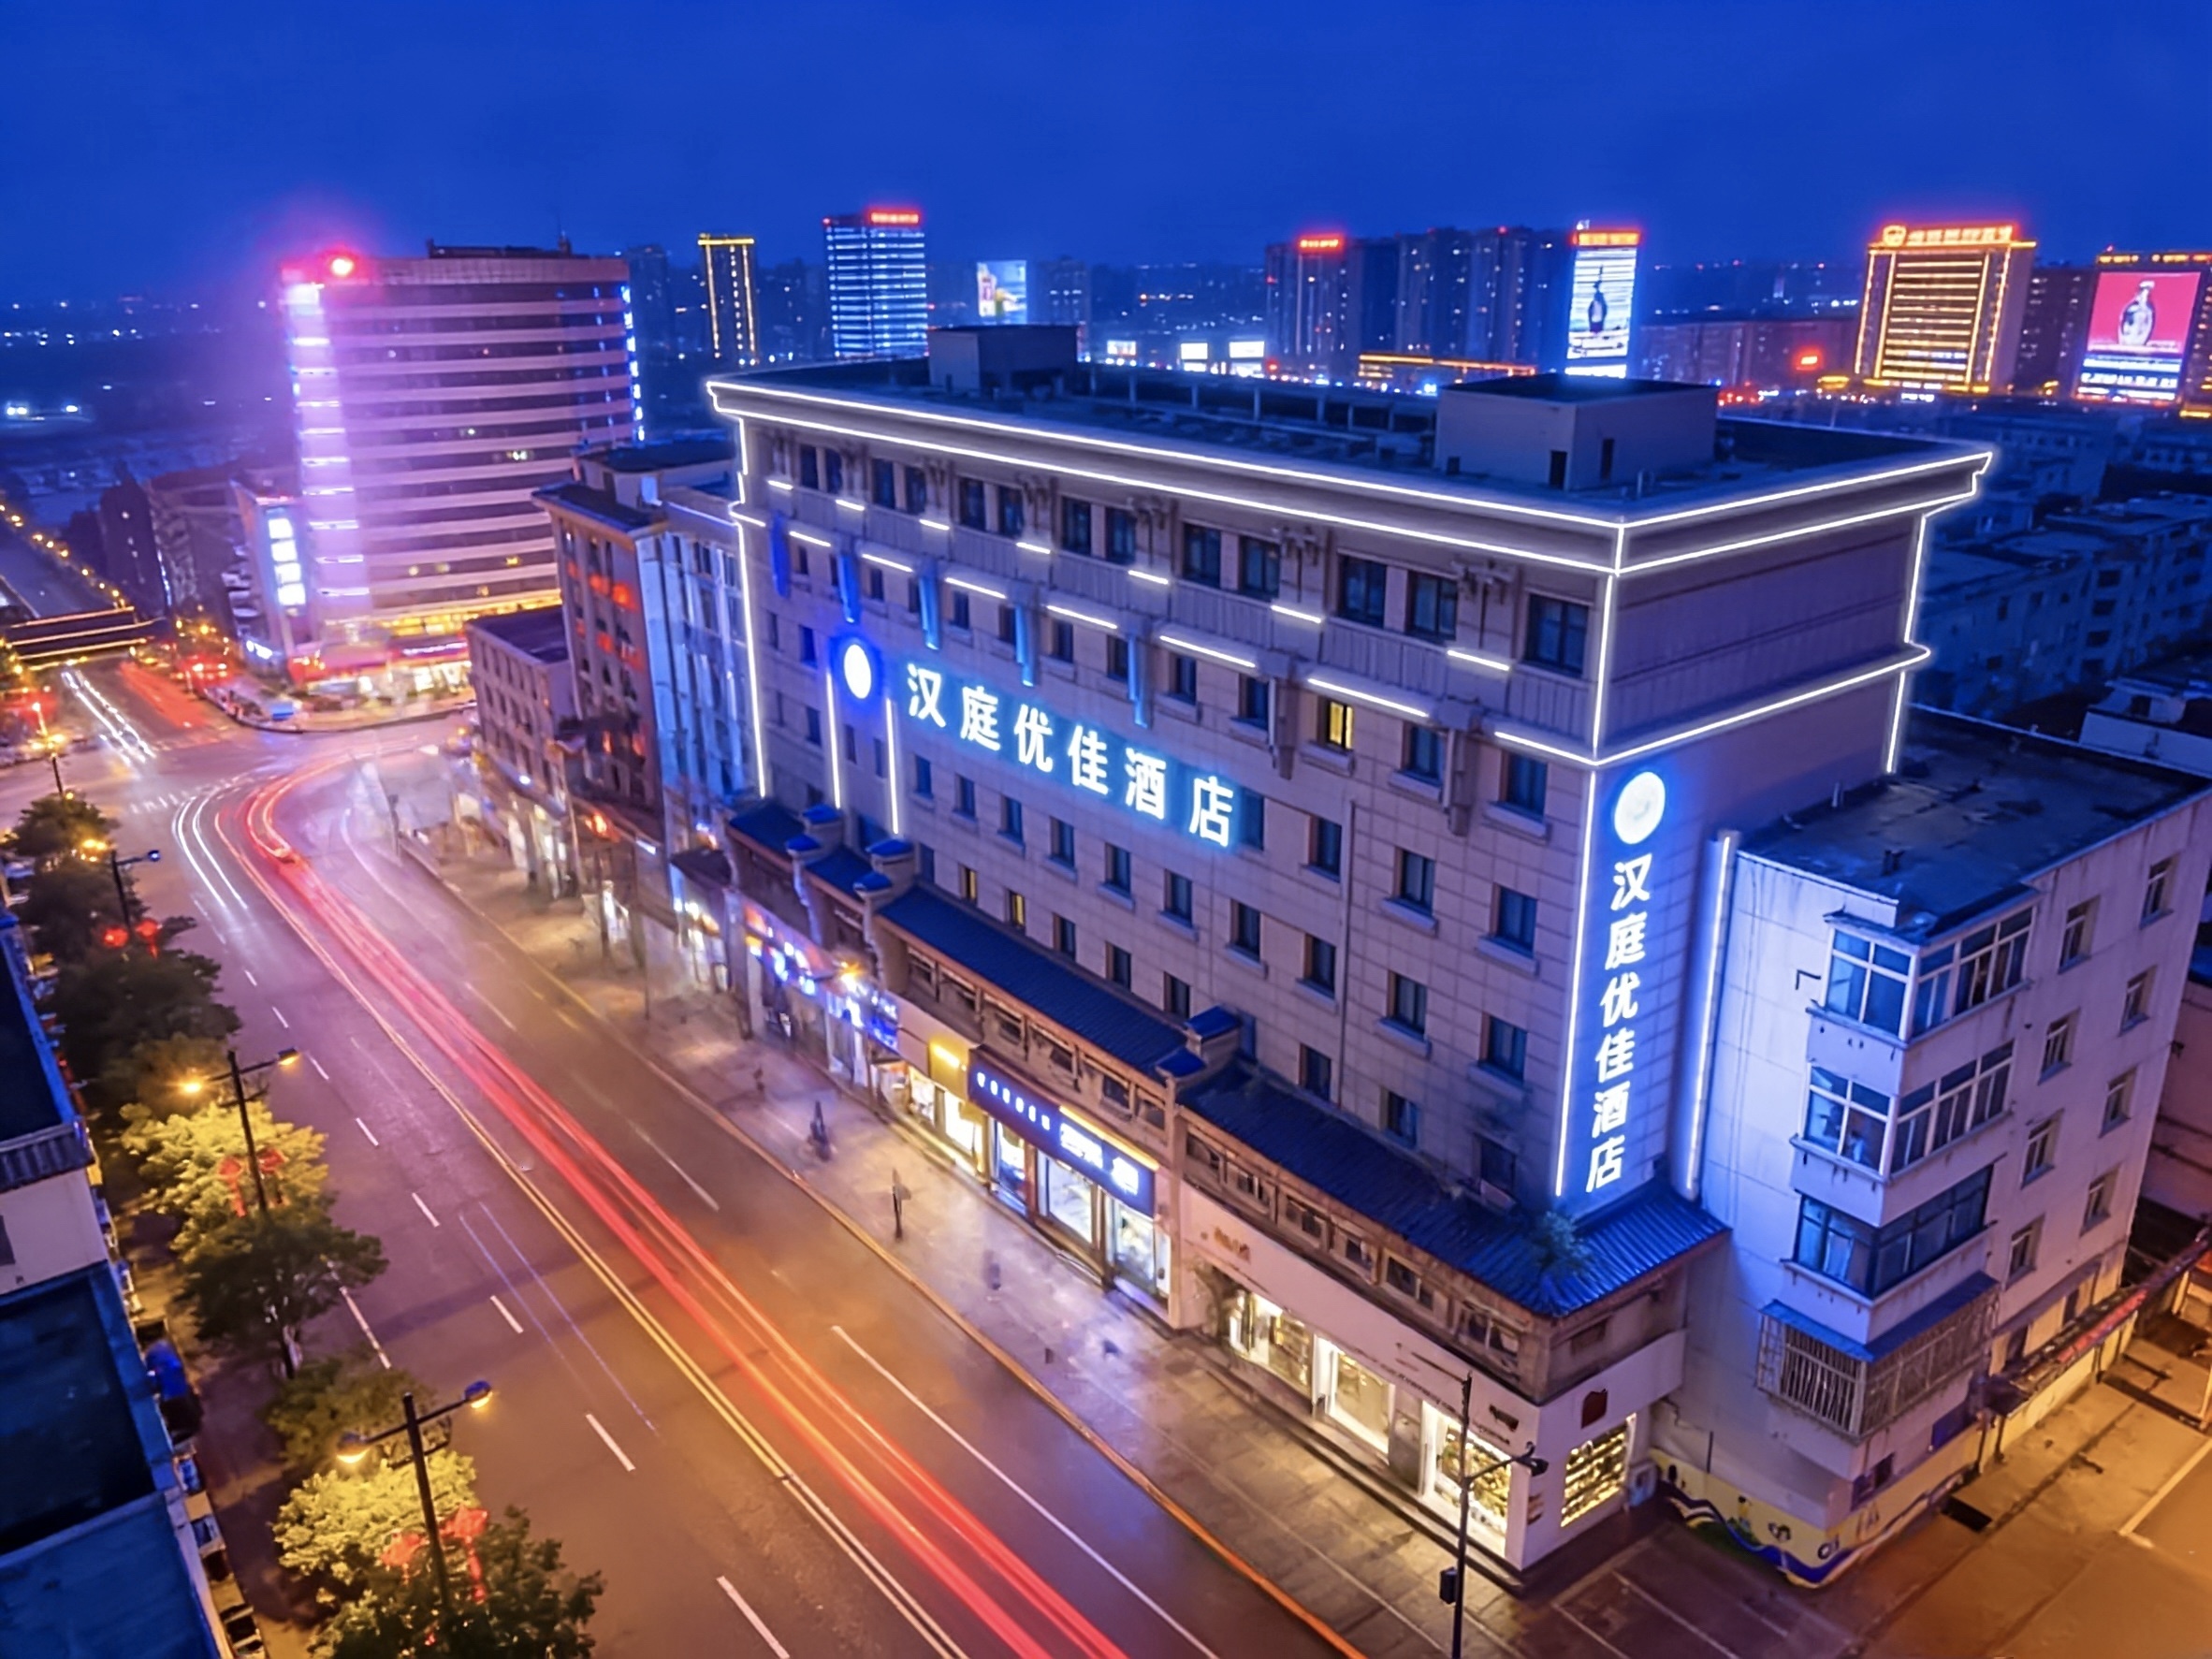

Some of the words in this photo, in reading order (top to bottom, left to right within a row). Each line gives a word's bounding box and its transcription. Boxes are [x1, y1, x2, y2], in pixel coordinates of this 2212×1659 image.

[907, 662, 1235, 848] 汉庭优佳酒店
[1585, 852, 1653, 1193] 汉庭优佳酒店
